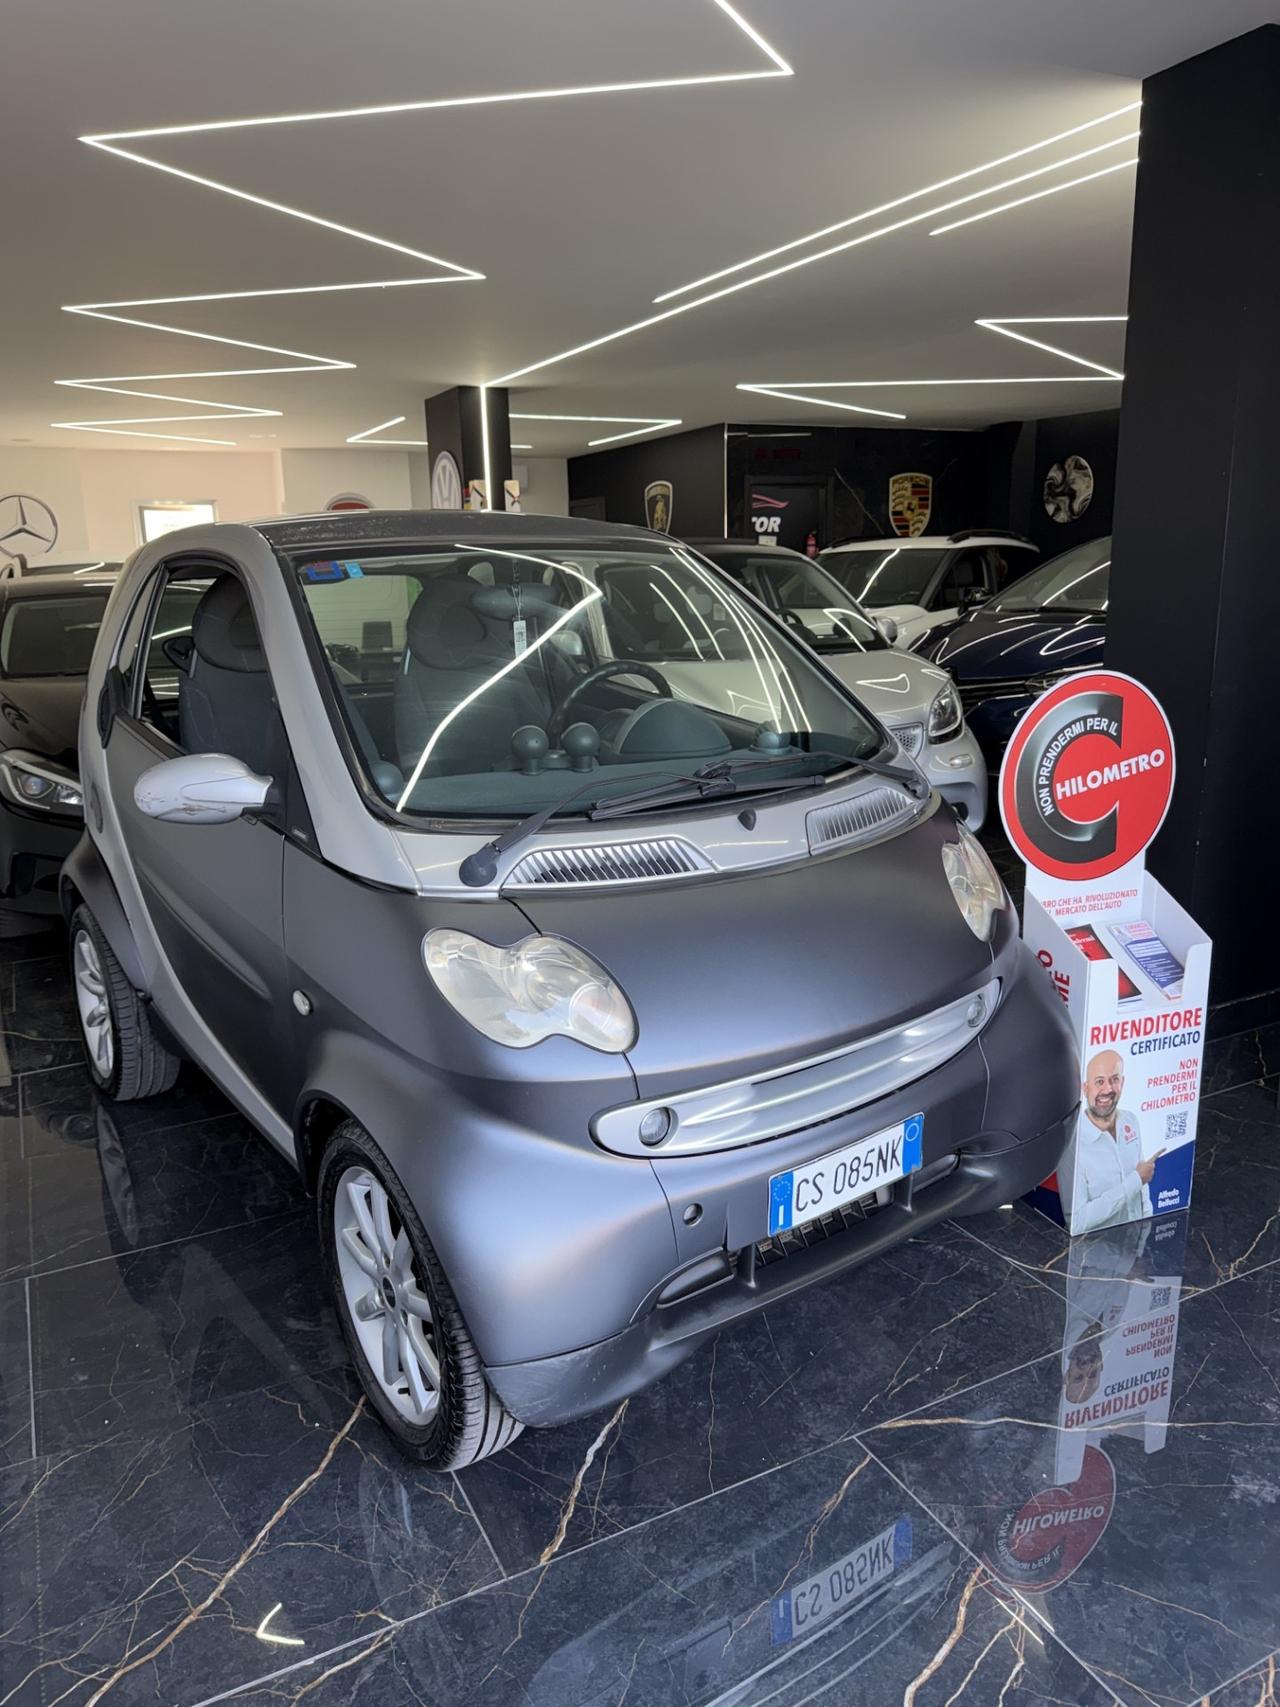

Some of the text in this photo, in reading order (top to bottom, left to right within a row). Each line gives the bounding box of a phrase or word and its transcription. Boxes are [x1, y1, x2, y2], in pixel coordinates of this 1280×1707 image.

[1039, 717, 1119, 816] NON PRENDERMI PER IL
[1055, 748, 1165, 800] HILOMETRO
[1085, 889, 1138, 904] RIVOLUZIONATO
[1055, 904, 1087, 916] MERCATO
[1088, 900, 1122, 912] DELL'AUTO
[1090, 1008, 1202, 1046] RIVENDITORE
[1130, 1030, 1201, 1056] CERTIFICATO
[1179, 1058, 1199, 1070] NON
[1147, 1070, 1198, 1088] PRENDERMI
[1172, 1081, 1197, 1094] PER IL
[1141, 1092, 1196, 1112] CHILOMETRO
[795, 1172, 825, 1212] CS
[833, 1135, 902, 1195] 085NK
